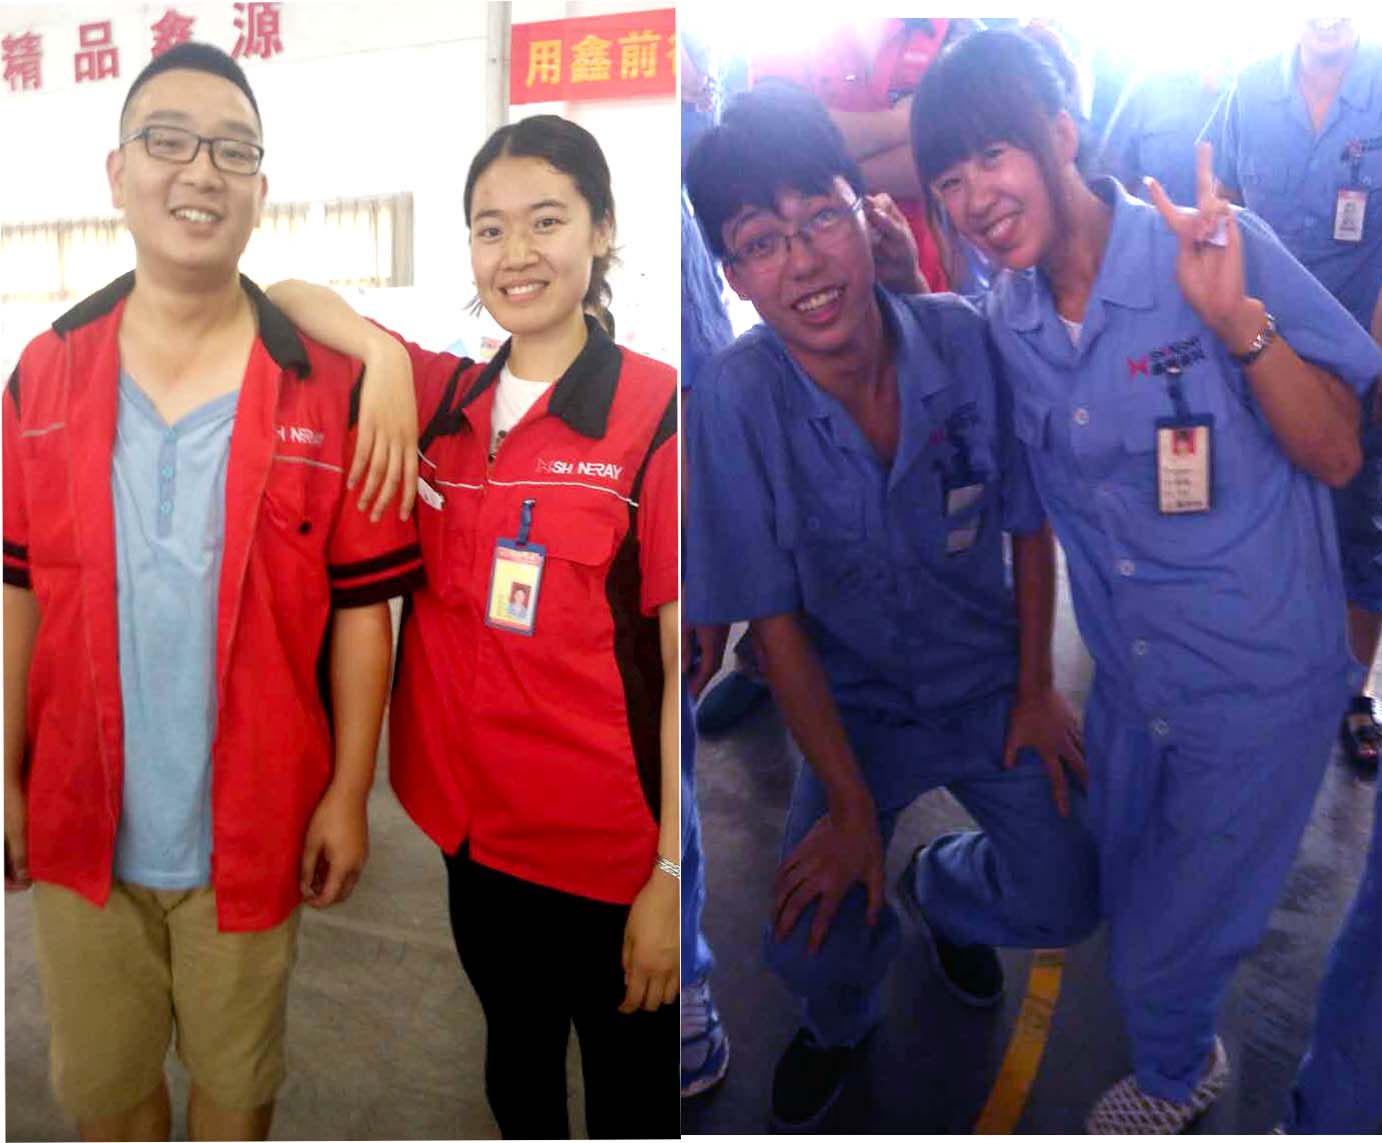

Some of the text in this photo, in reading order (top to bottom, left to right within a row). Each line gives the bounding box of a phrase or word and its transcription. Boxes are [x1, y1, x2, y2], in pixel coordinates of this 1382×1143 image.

[525, 29, 676, 89] 用鑫前
[551, 460, 624, 481] SHNERAY
